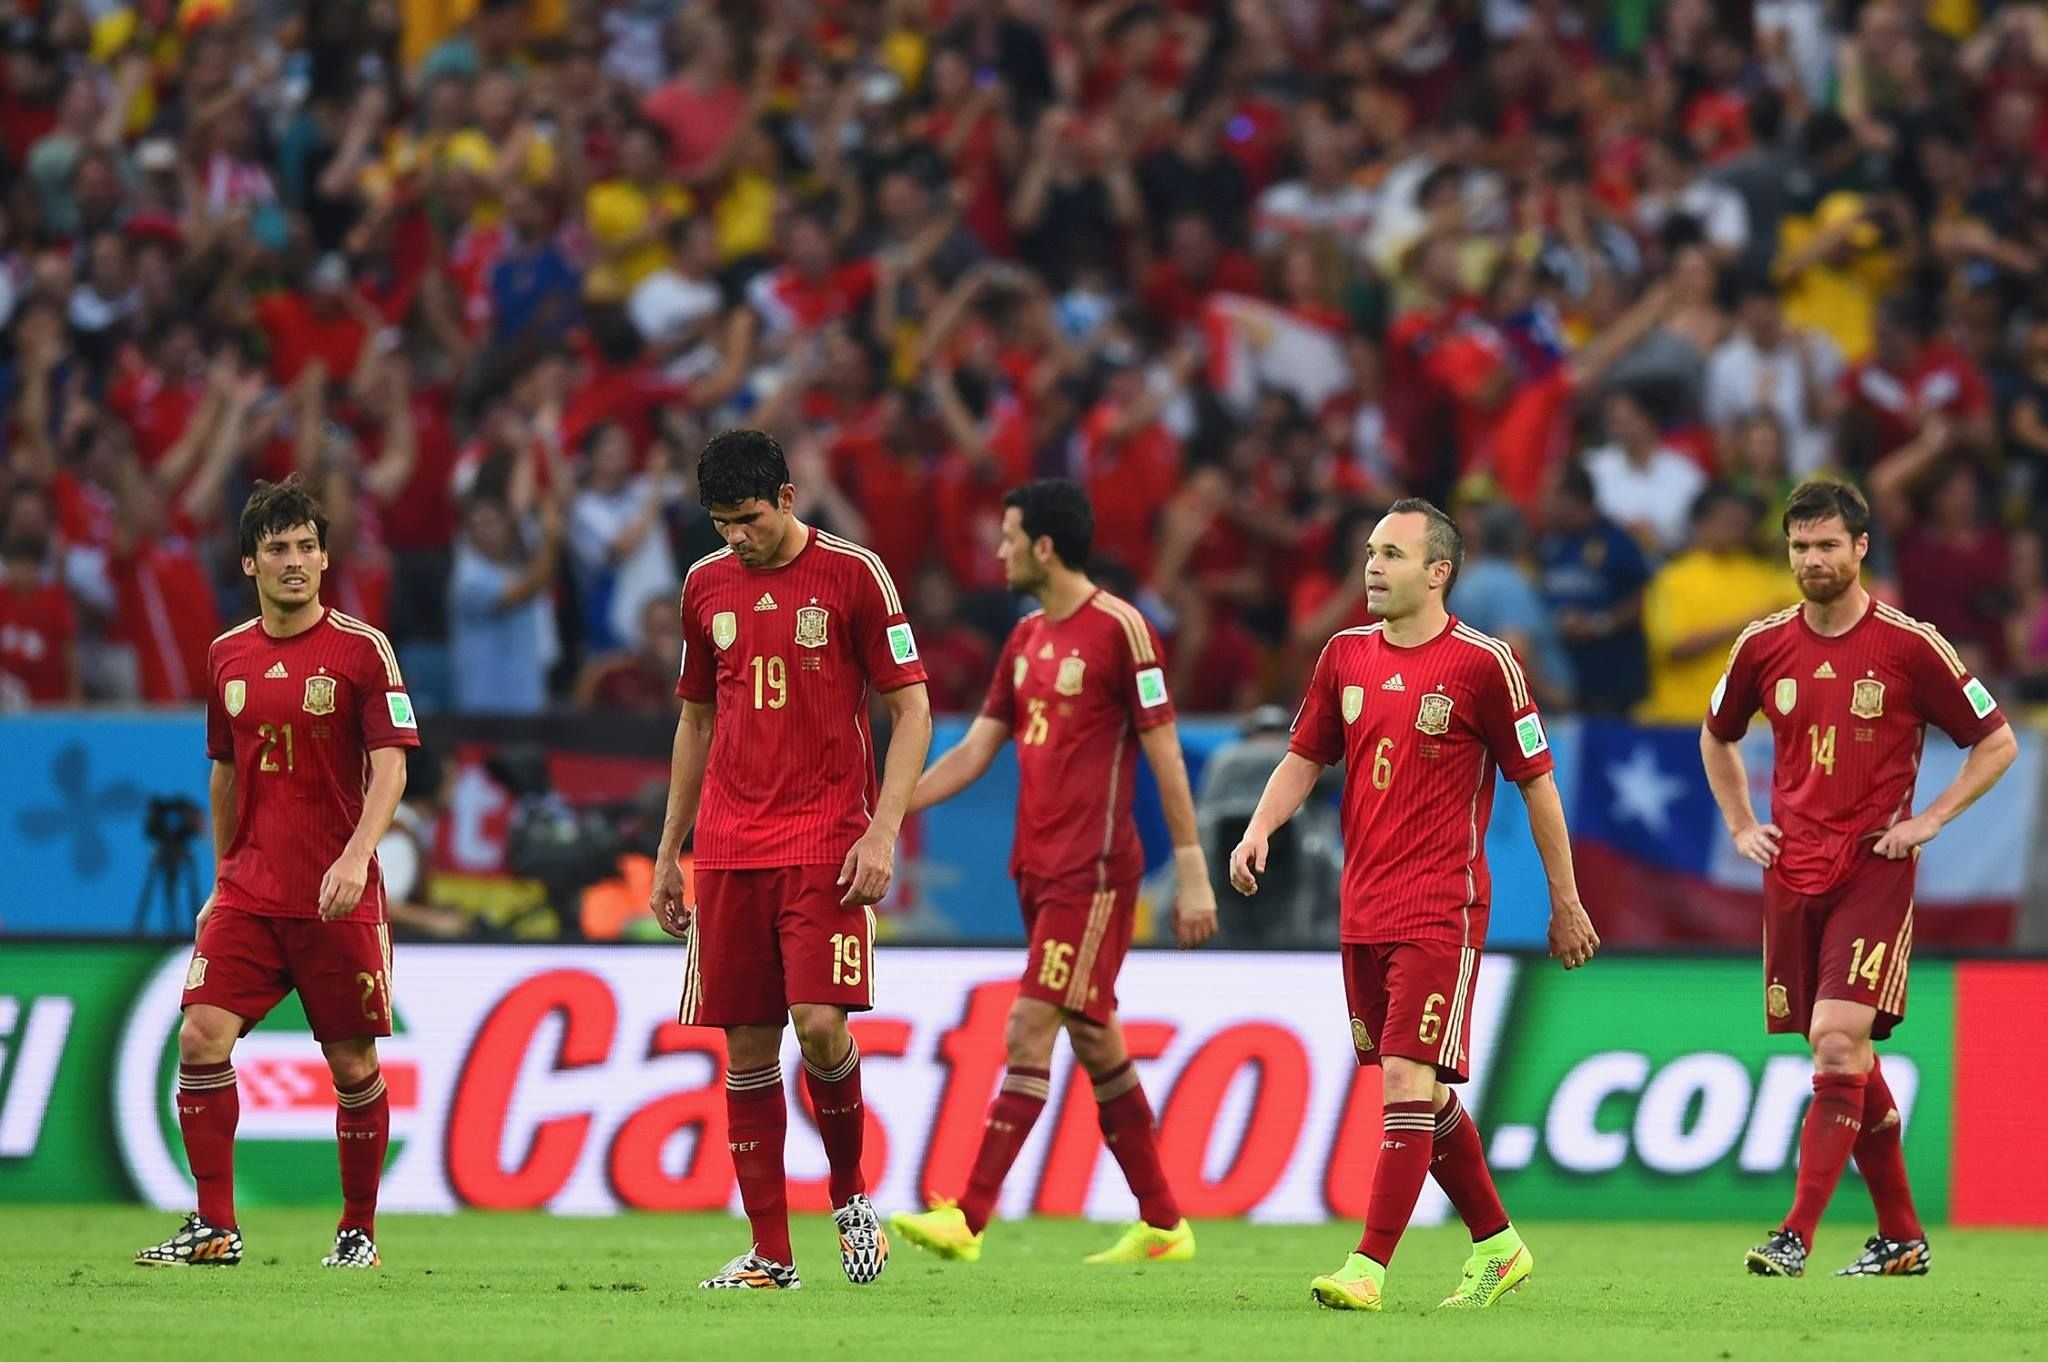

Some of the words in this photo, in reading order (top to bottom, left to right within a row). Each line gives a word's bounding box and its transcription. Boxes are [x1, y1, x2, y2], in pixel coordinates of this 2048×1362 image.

[750, 656, 787, 709] 19
[258, 723, 294, 772] 21
[1372, 737, 1394, 790] 6
[1808, 724, 1836, 775] 14
[829, 933, 861, 986] 19
[1038, 938, 1075, 991] 16
[1847, 938, 1886, 991] 14
[356, 970, 389, 1020] 21
[1419, 993, 1446, 1045] 6
